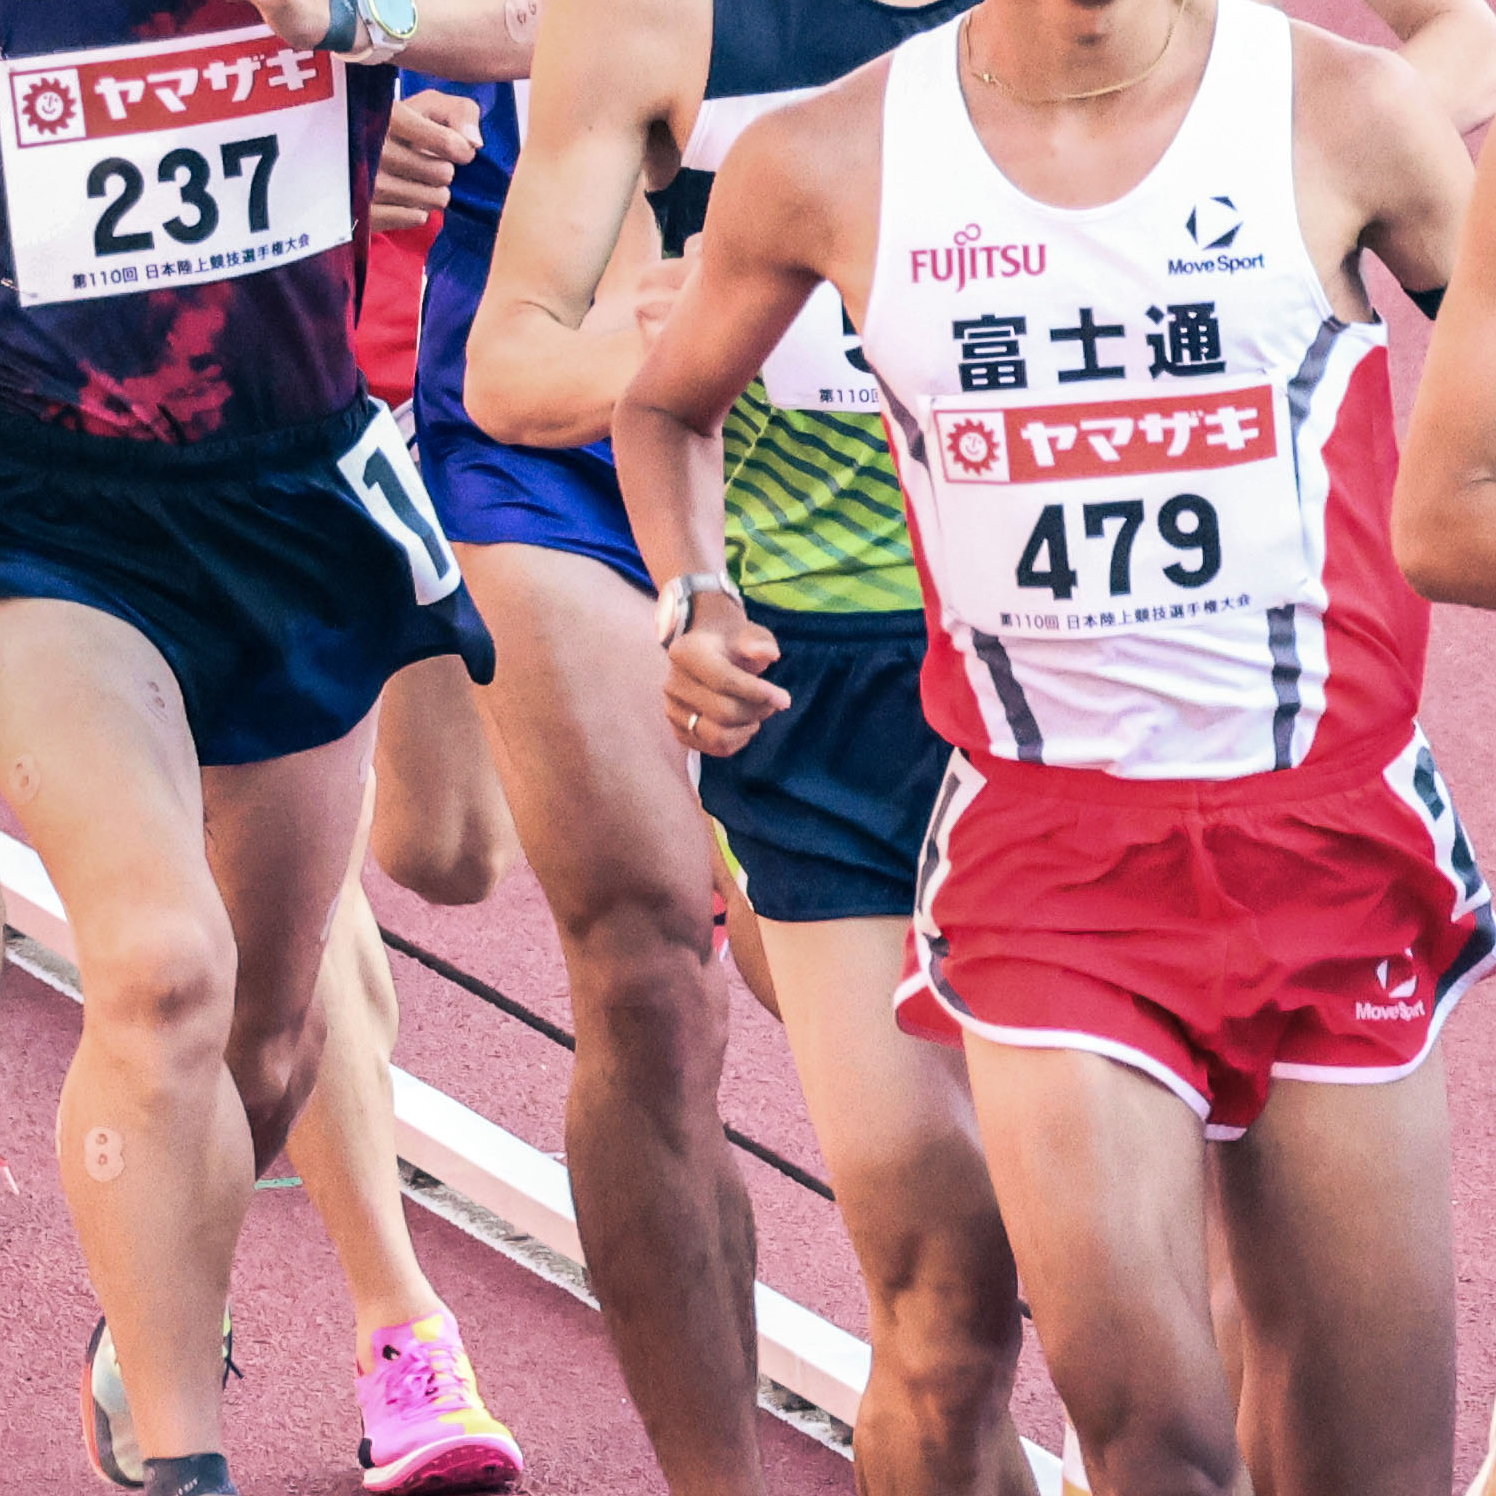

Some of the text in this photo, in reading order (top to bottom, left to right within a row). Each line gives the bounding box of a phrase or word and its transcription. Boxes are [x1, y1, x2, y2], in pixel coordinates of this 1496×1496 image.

[94, 47, 316, 120] ヤマザキ
[85, 135, 281, 258] 237
[72, 234, 311, 291] 第110回 日本陸上競技選手権大会
[909, 239, 1047, 291] FUJITSU
[952, 301, 1227, 392] 富士通
[1020, 405, 1260, 468] ヤマザキ
[1014, 493, 1223, 601] 479
[1000, 594, 1252, 631] 第110回 日本陸上競技選手権大会
